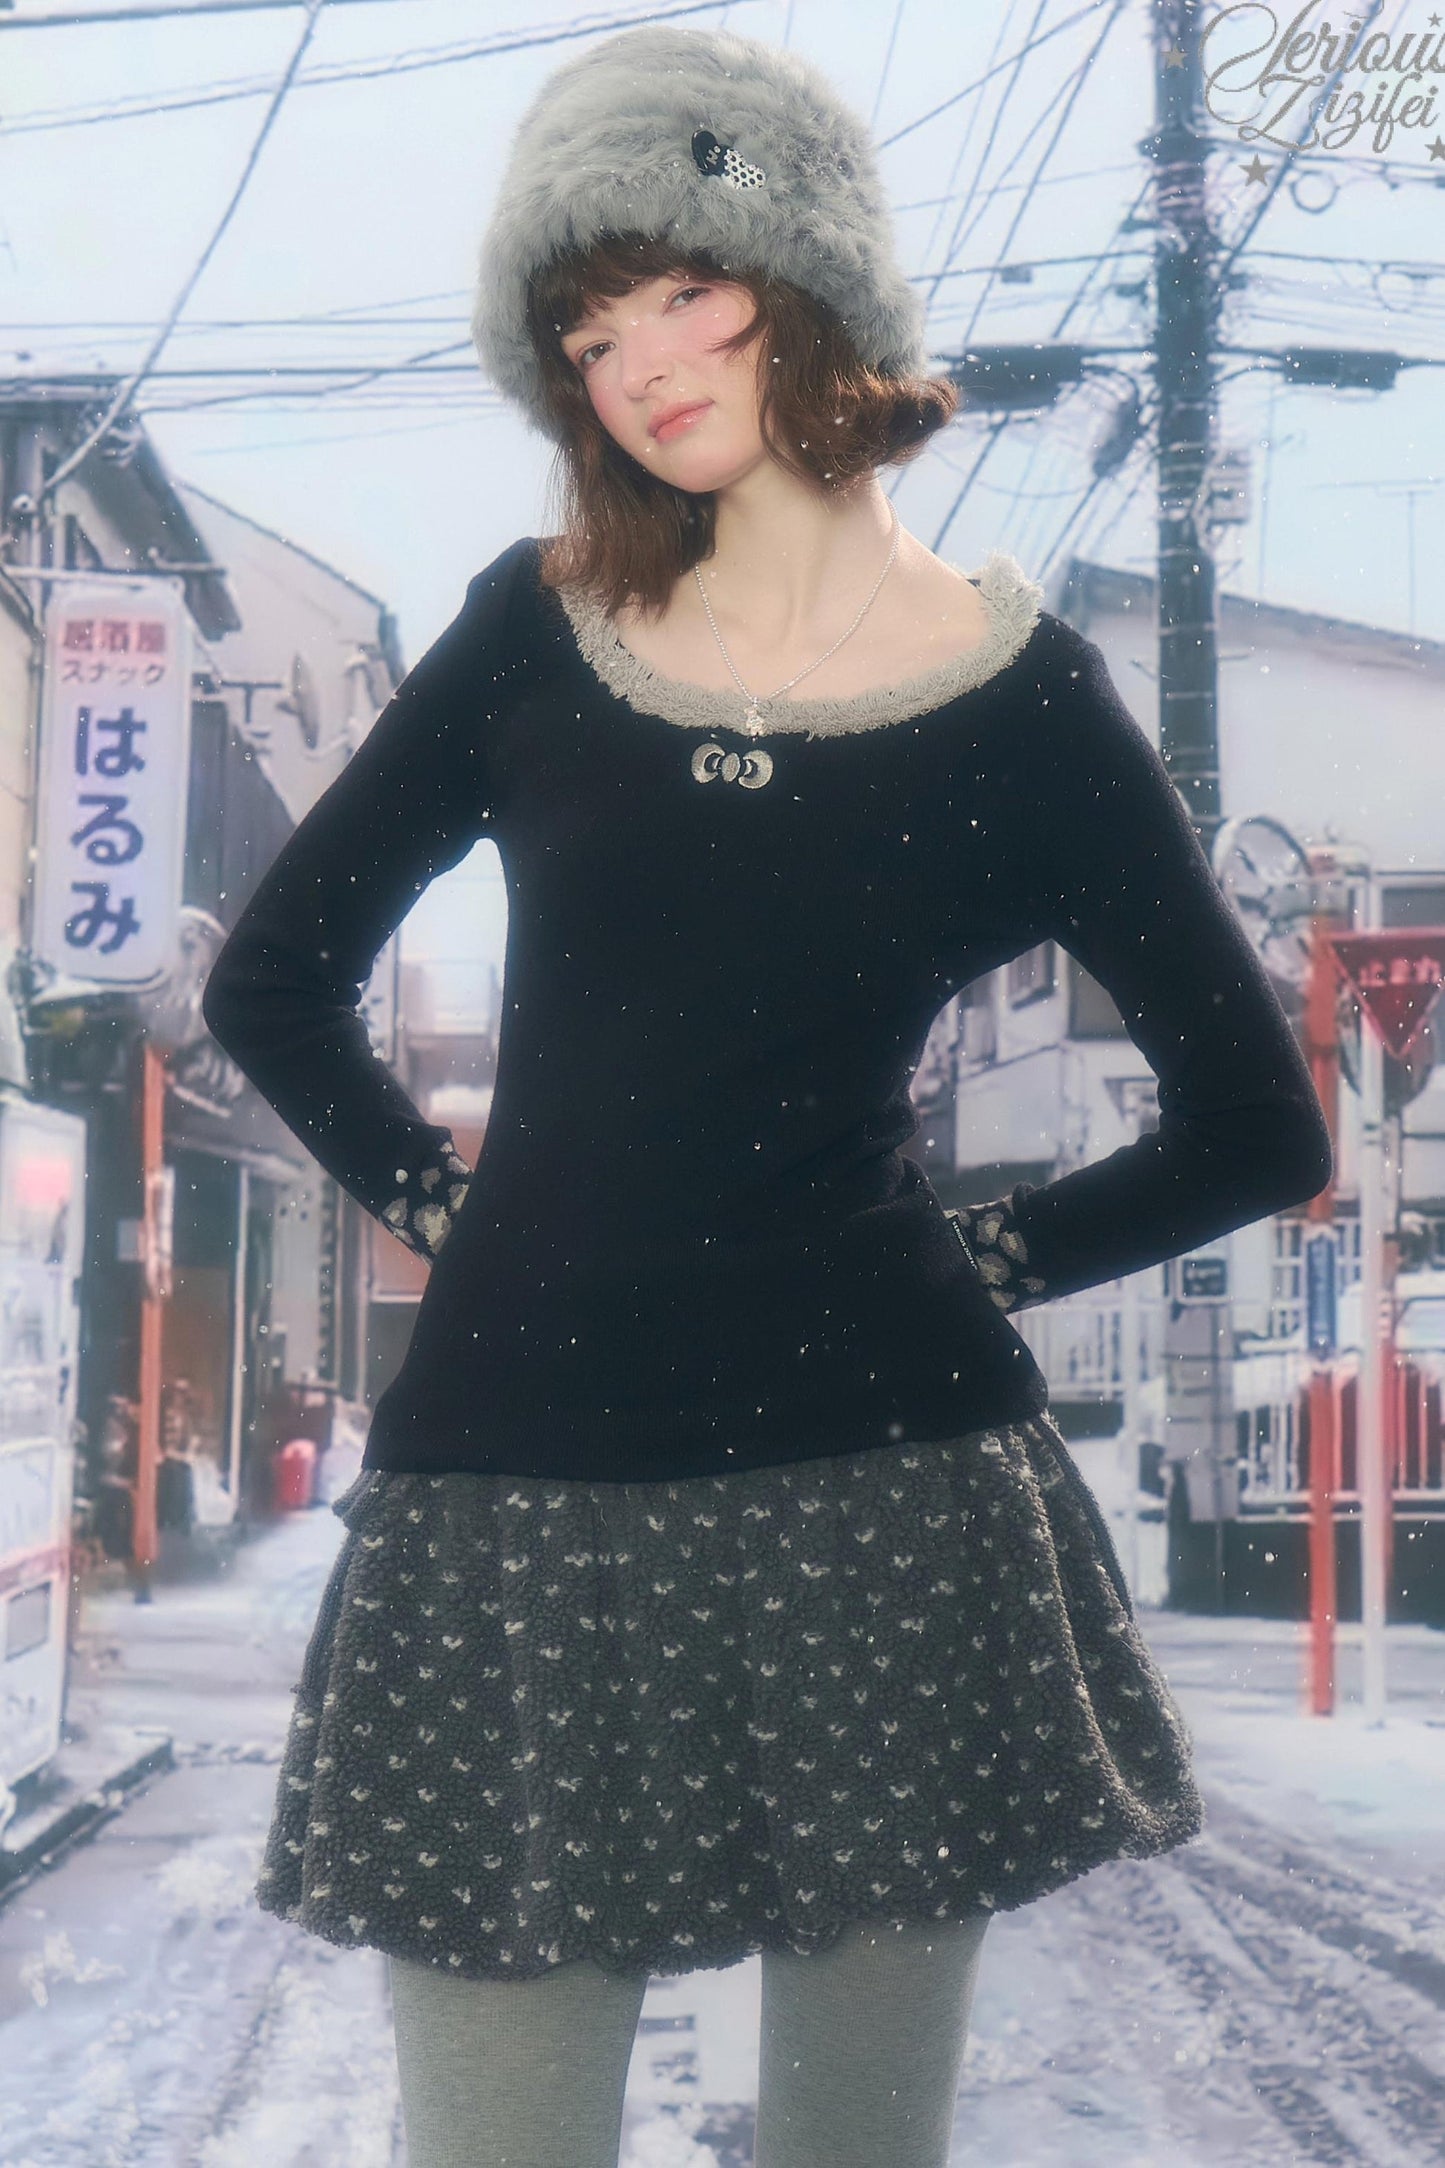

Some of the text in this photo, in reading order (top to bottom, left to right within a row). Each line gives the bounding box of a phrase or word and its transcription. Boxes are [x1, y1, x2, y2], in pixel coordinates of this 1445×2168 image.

[61, 660, 165, 686] スナック
[64, 706, 147, 954] はるみ
